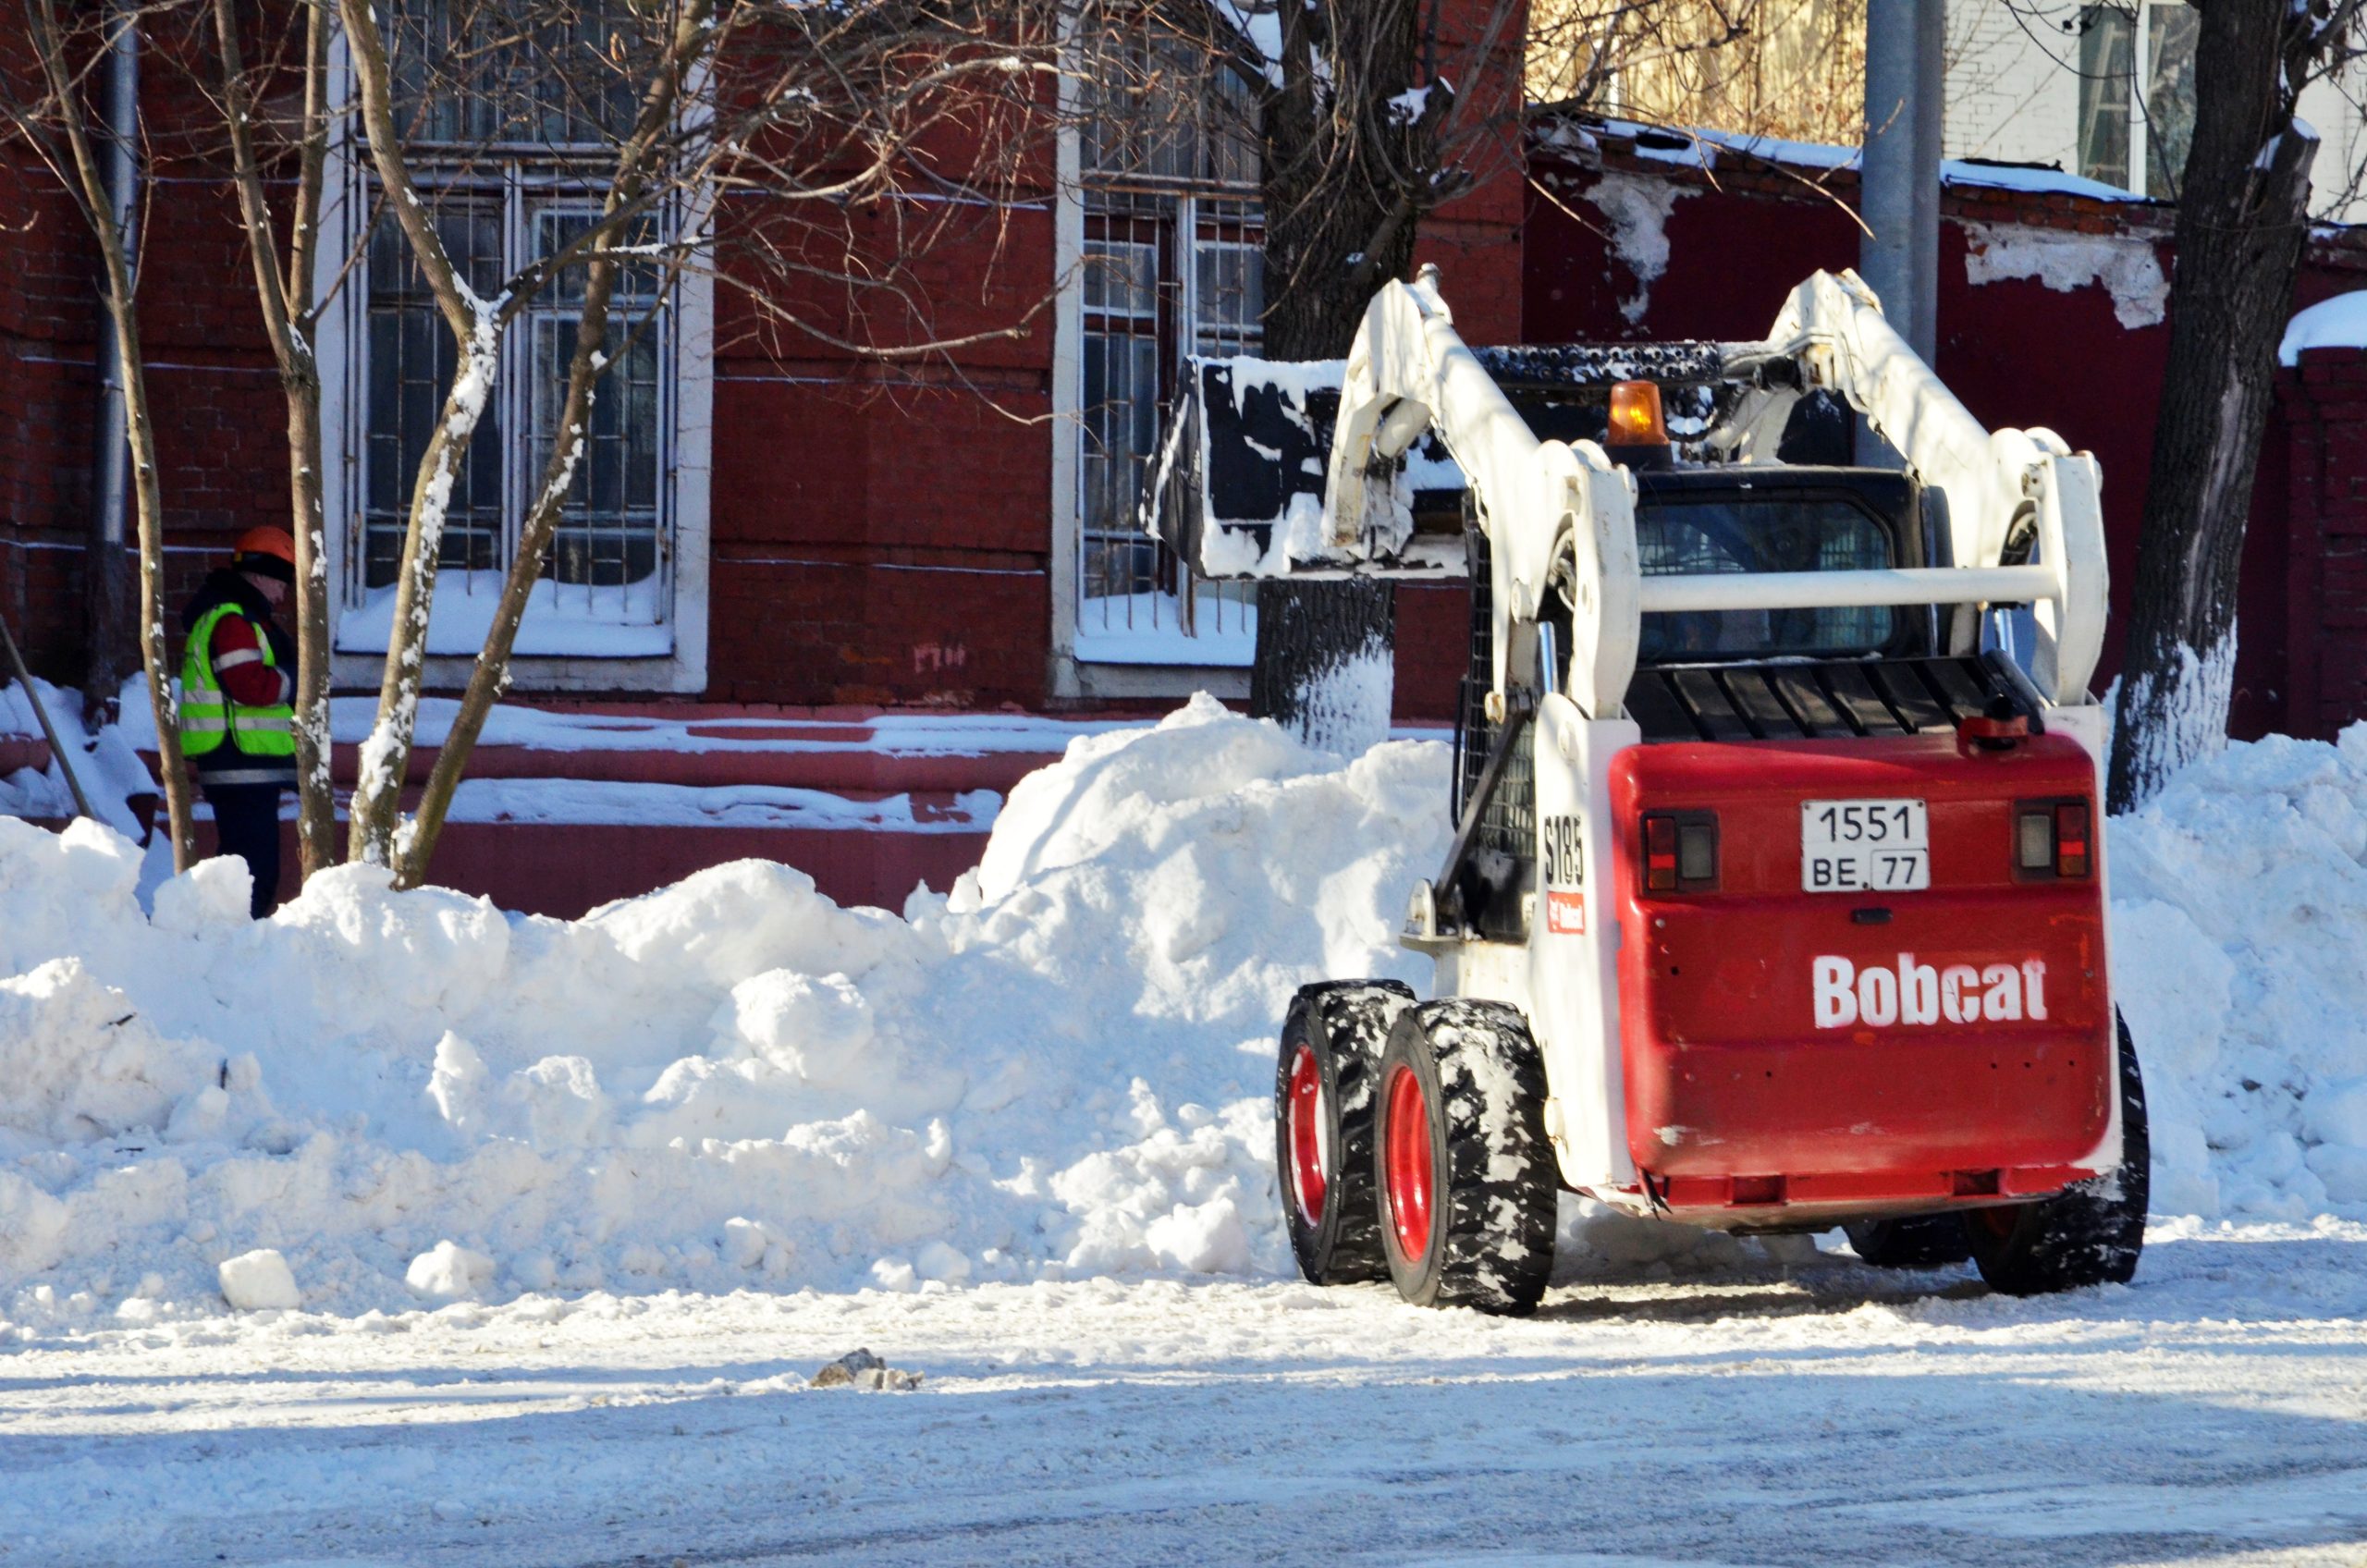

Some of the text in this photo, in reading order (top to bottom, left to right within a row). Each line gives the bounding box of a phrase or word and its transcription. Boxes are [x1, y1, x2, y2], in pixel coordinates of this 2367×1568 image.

[1544, 815, 1584, 885] S185
[1820, 806, 1910, 842] 1551
[1882, 857, 1917, 884] 77
[1813, 952, 2047, 1028] Bobcat
